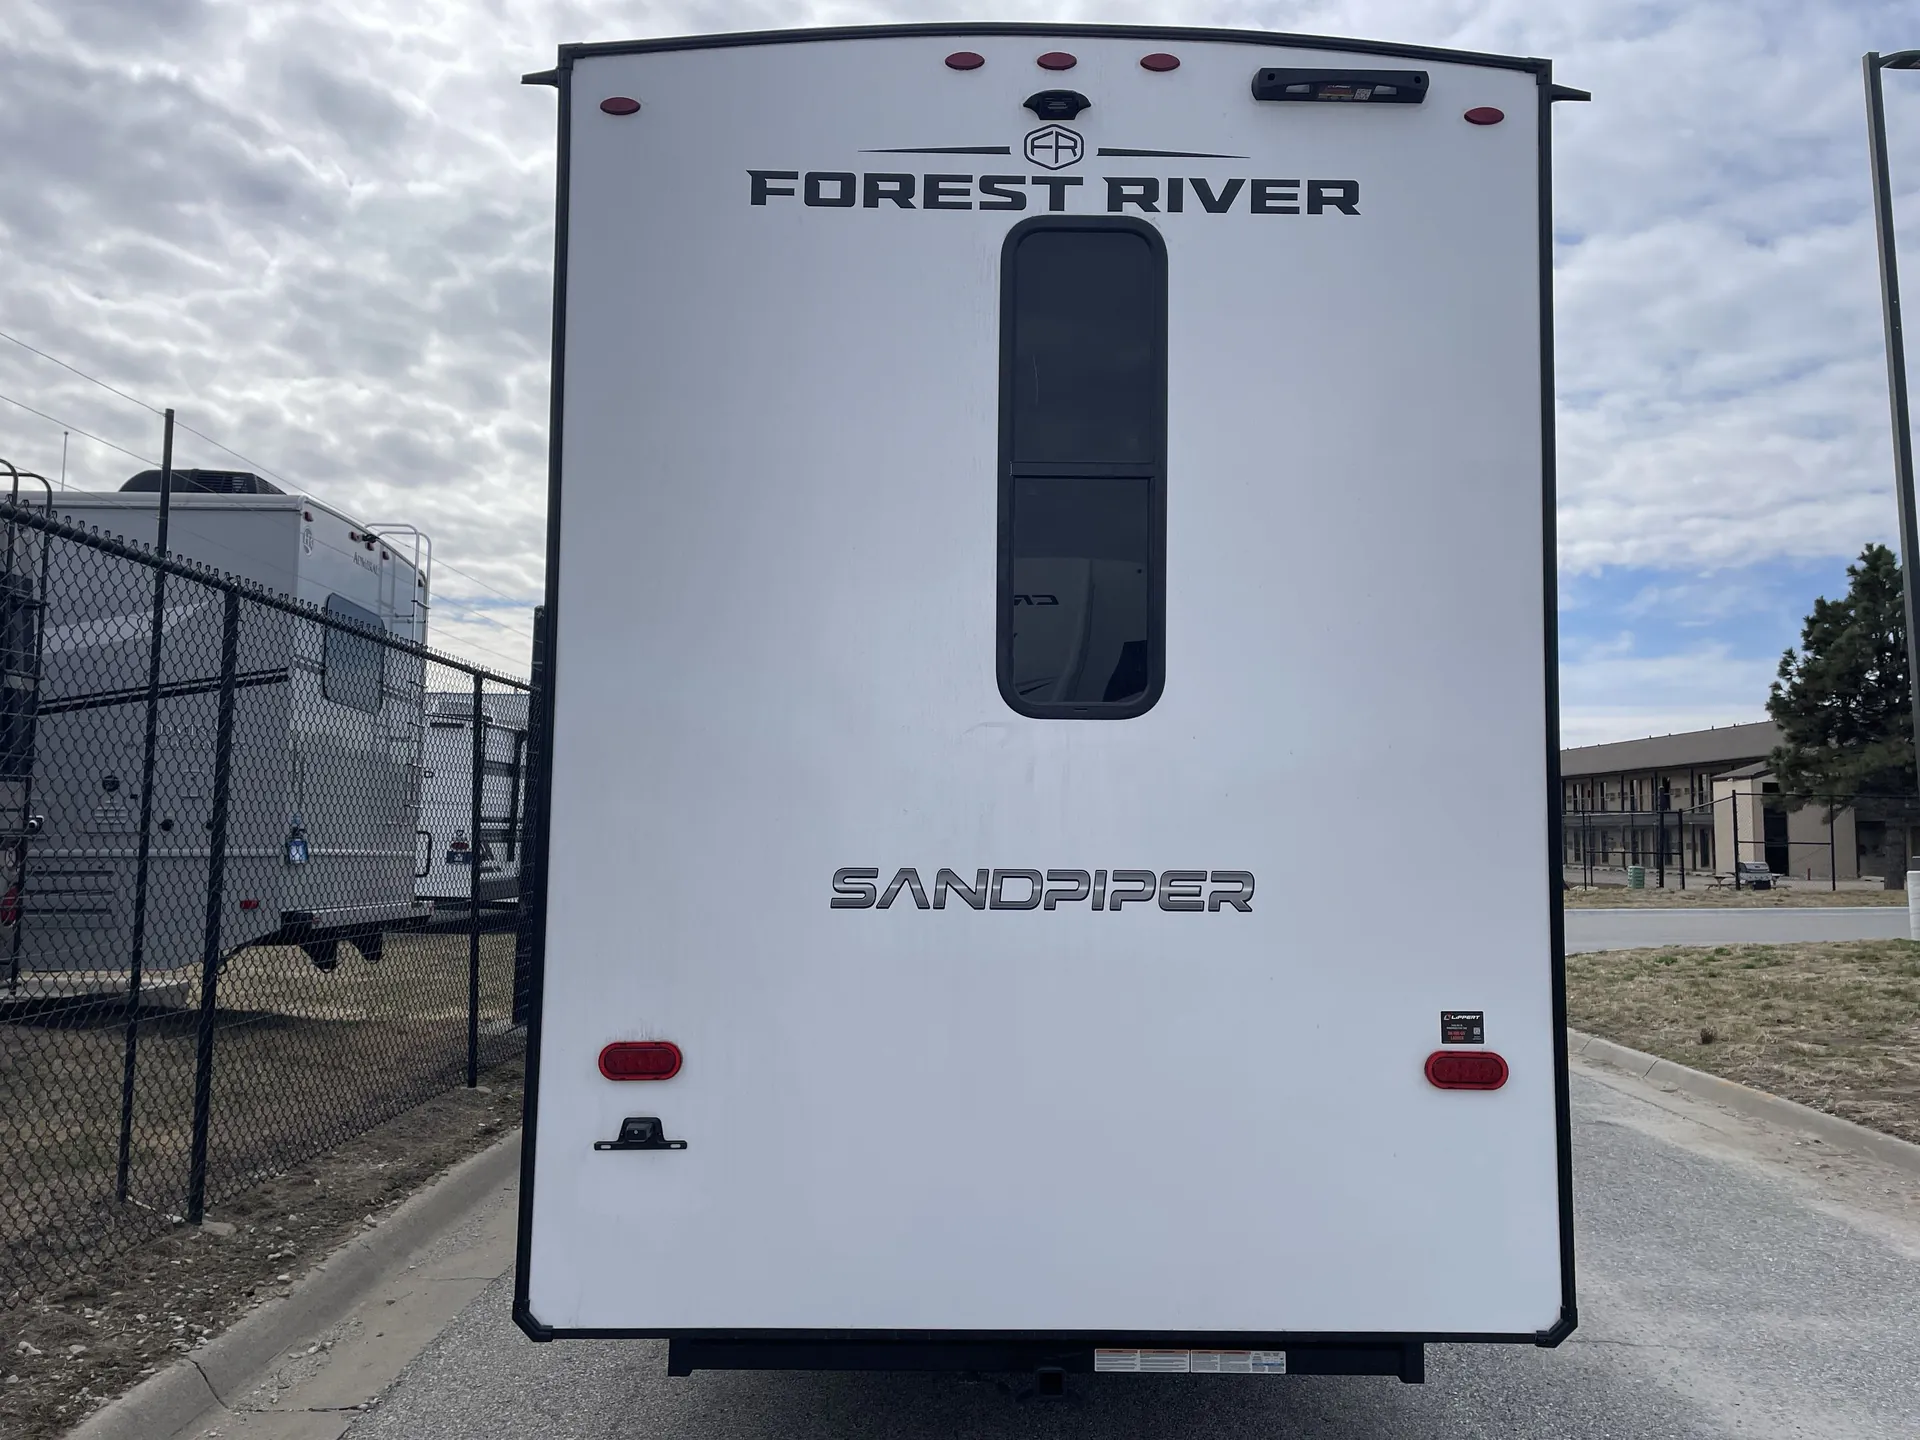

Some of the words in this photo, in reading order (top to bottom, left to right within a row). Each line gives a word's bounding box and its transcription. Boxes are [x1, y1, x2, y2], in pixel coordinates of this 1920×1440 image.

[1030, 130, 1078, 164] FR
[747, 170, 1084, 211] FOREST
[1102, 177, 1361, 215] RIVER
[831, 867, 1255, 912] SANDPIPER
